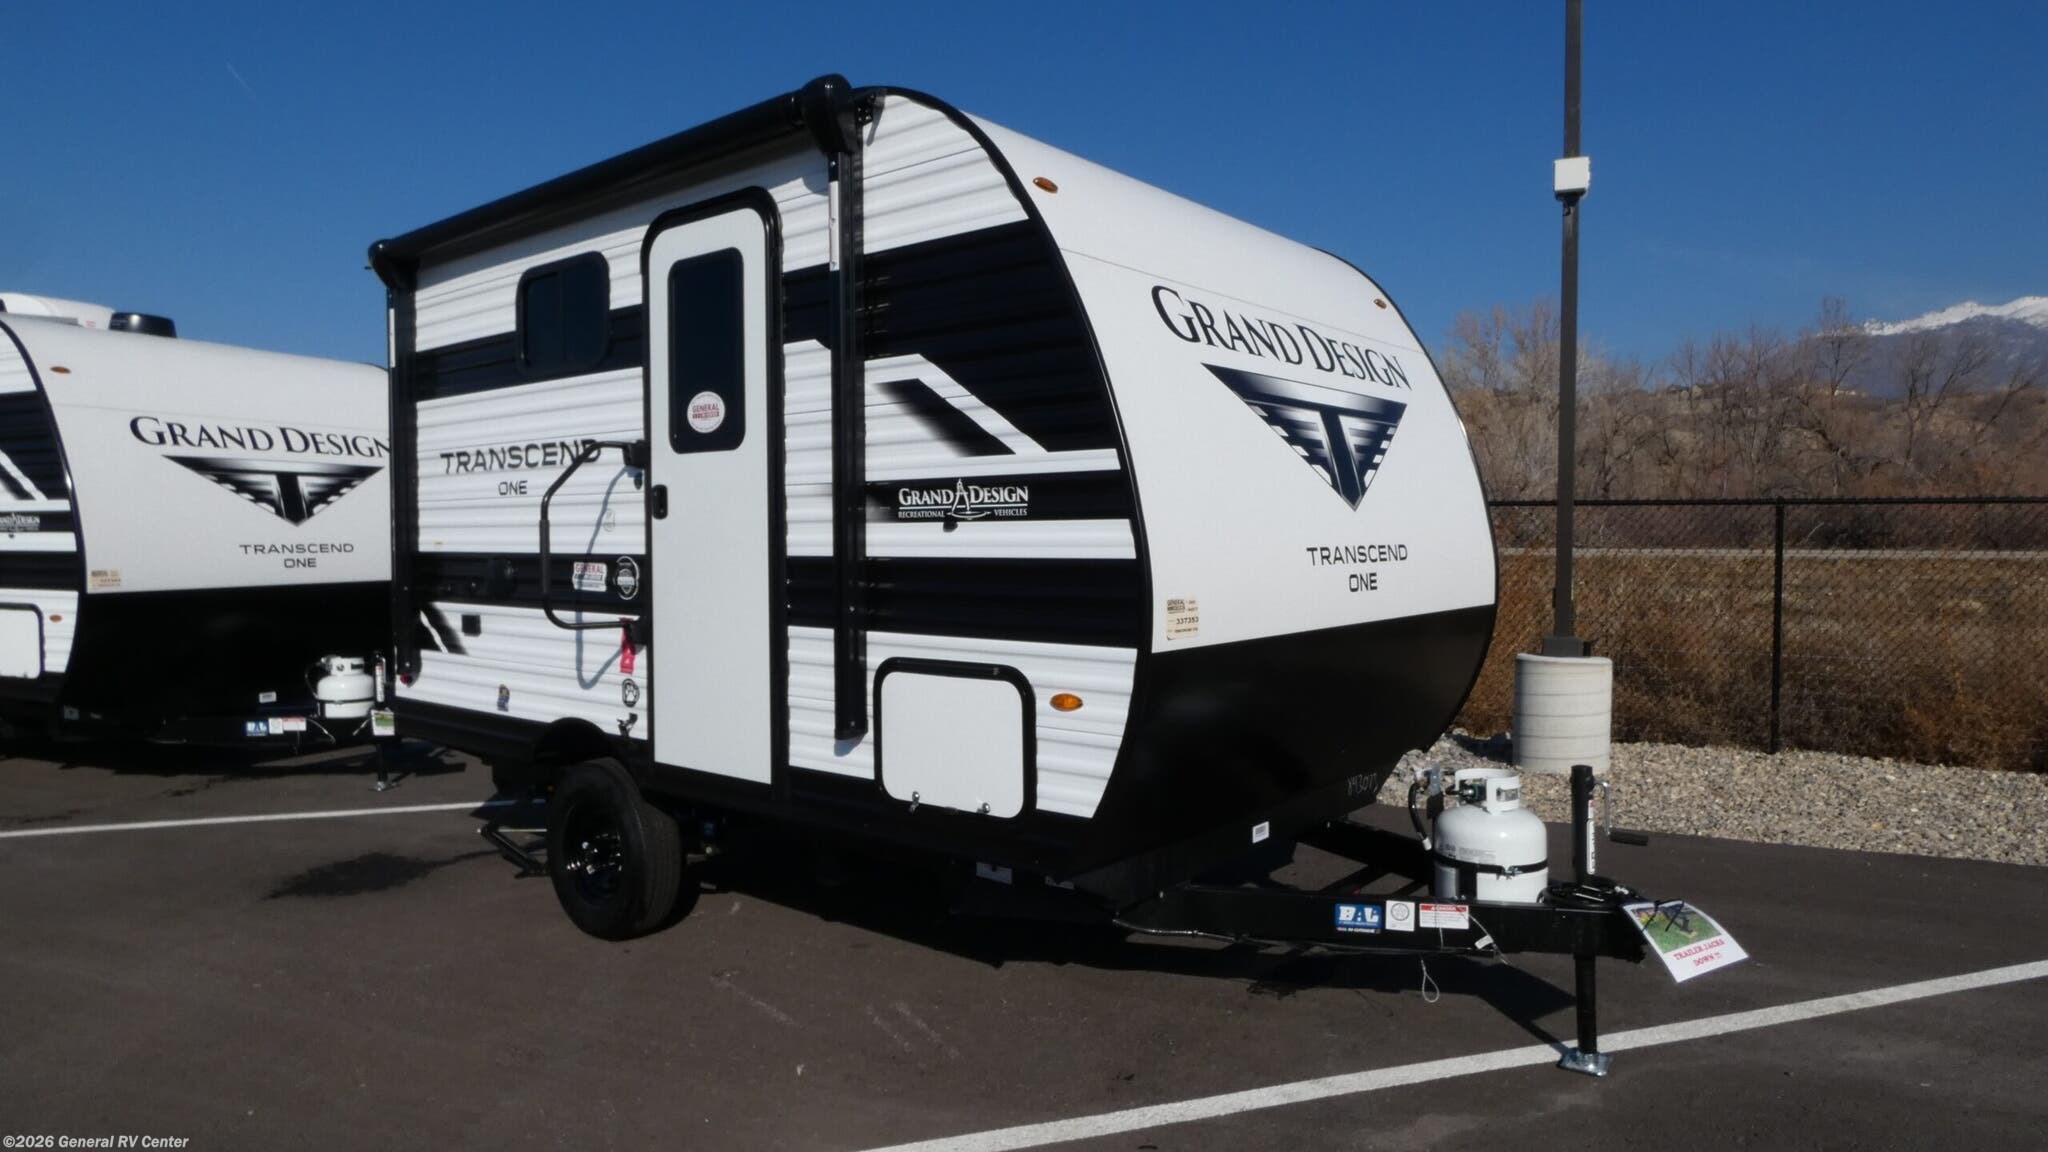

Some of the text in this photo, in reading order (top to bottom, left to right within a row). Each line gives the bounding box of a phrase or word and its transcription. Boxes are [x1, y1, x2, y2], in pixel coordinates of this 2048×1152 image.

[1151, 284, 1412, 390] GRAND DESIGN
[129, 416, 274, 451] GRAND
[440, 439, 601, 475] TRANSCEND
[498, 480, 528, 496] ONE
[898, 485, 1028, 506] GRAND DESIGN
[898, 508, 1027, 518] RECREATIONAL VEHICLES
[239, 543, 355, 555] TRANSCEND
[1306, 544, 1408, 566] TRANSCEND
[284, 558, 317, 569] ONE
[1349, 573, 1378, 593] ONE
